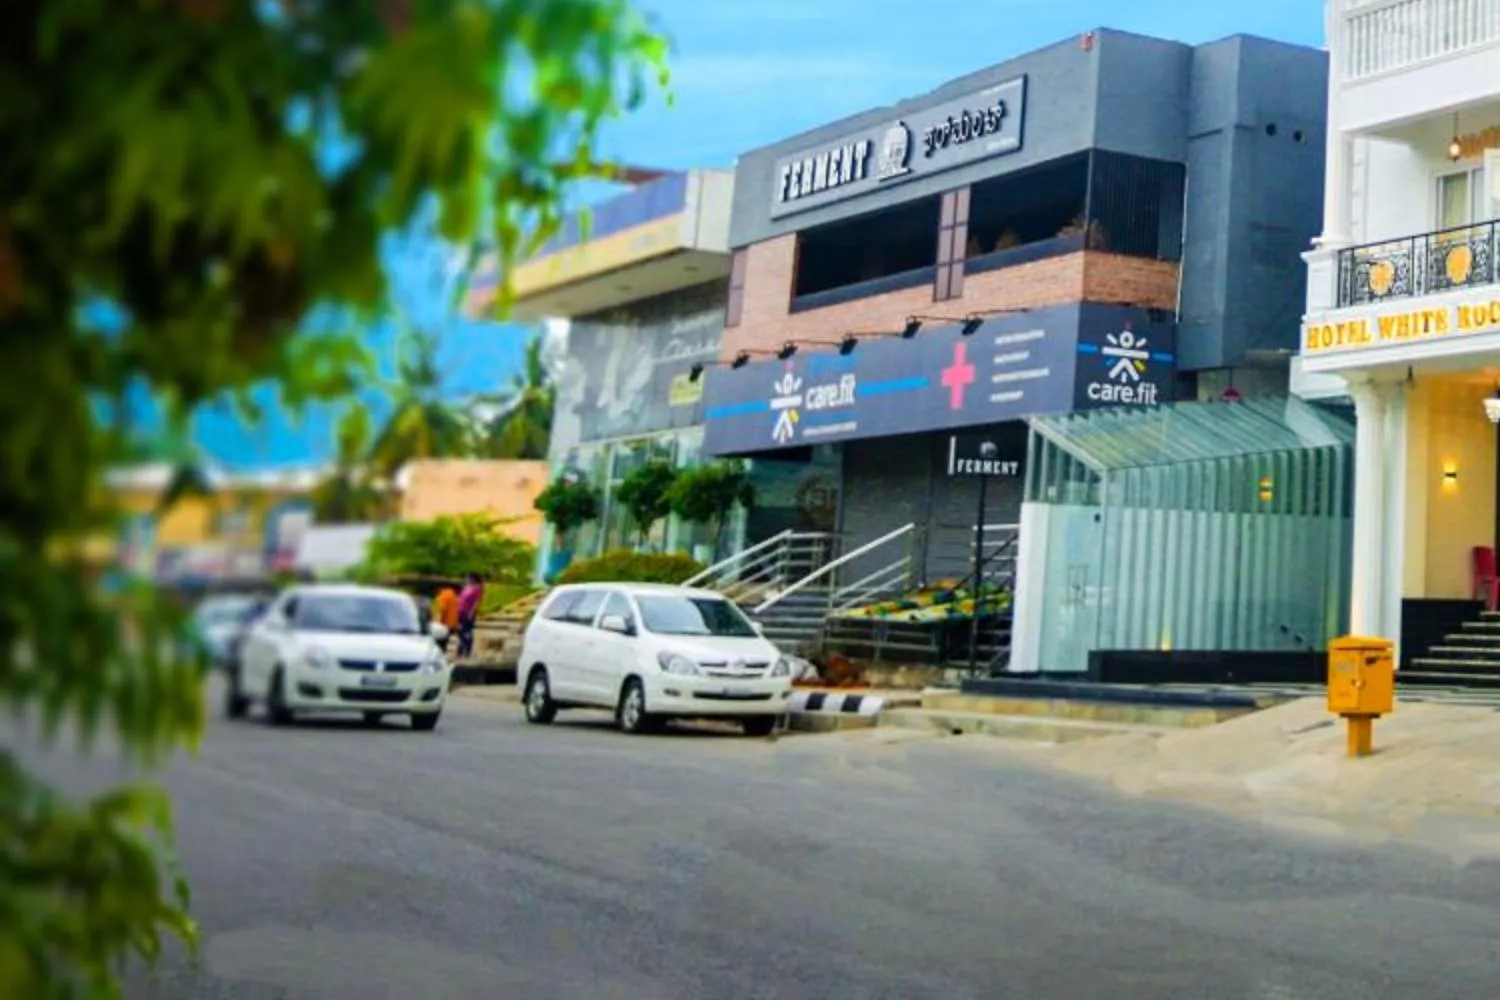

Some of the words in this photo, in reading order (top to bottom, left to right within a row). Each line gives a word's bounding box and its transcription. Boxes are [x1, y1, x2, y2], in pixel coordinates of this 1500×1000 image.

[779, 139, 870, 202] FERMENT
[1306, 319, 1373, 349] HOTEL
[1377, 308, 1449, 341] WHITE
[805, 372, 856, 410] care.fit
[1087, 381, 1158, 405] care.fit
[957, 457, 1019, 476] FERMENT
